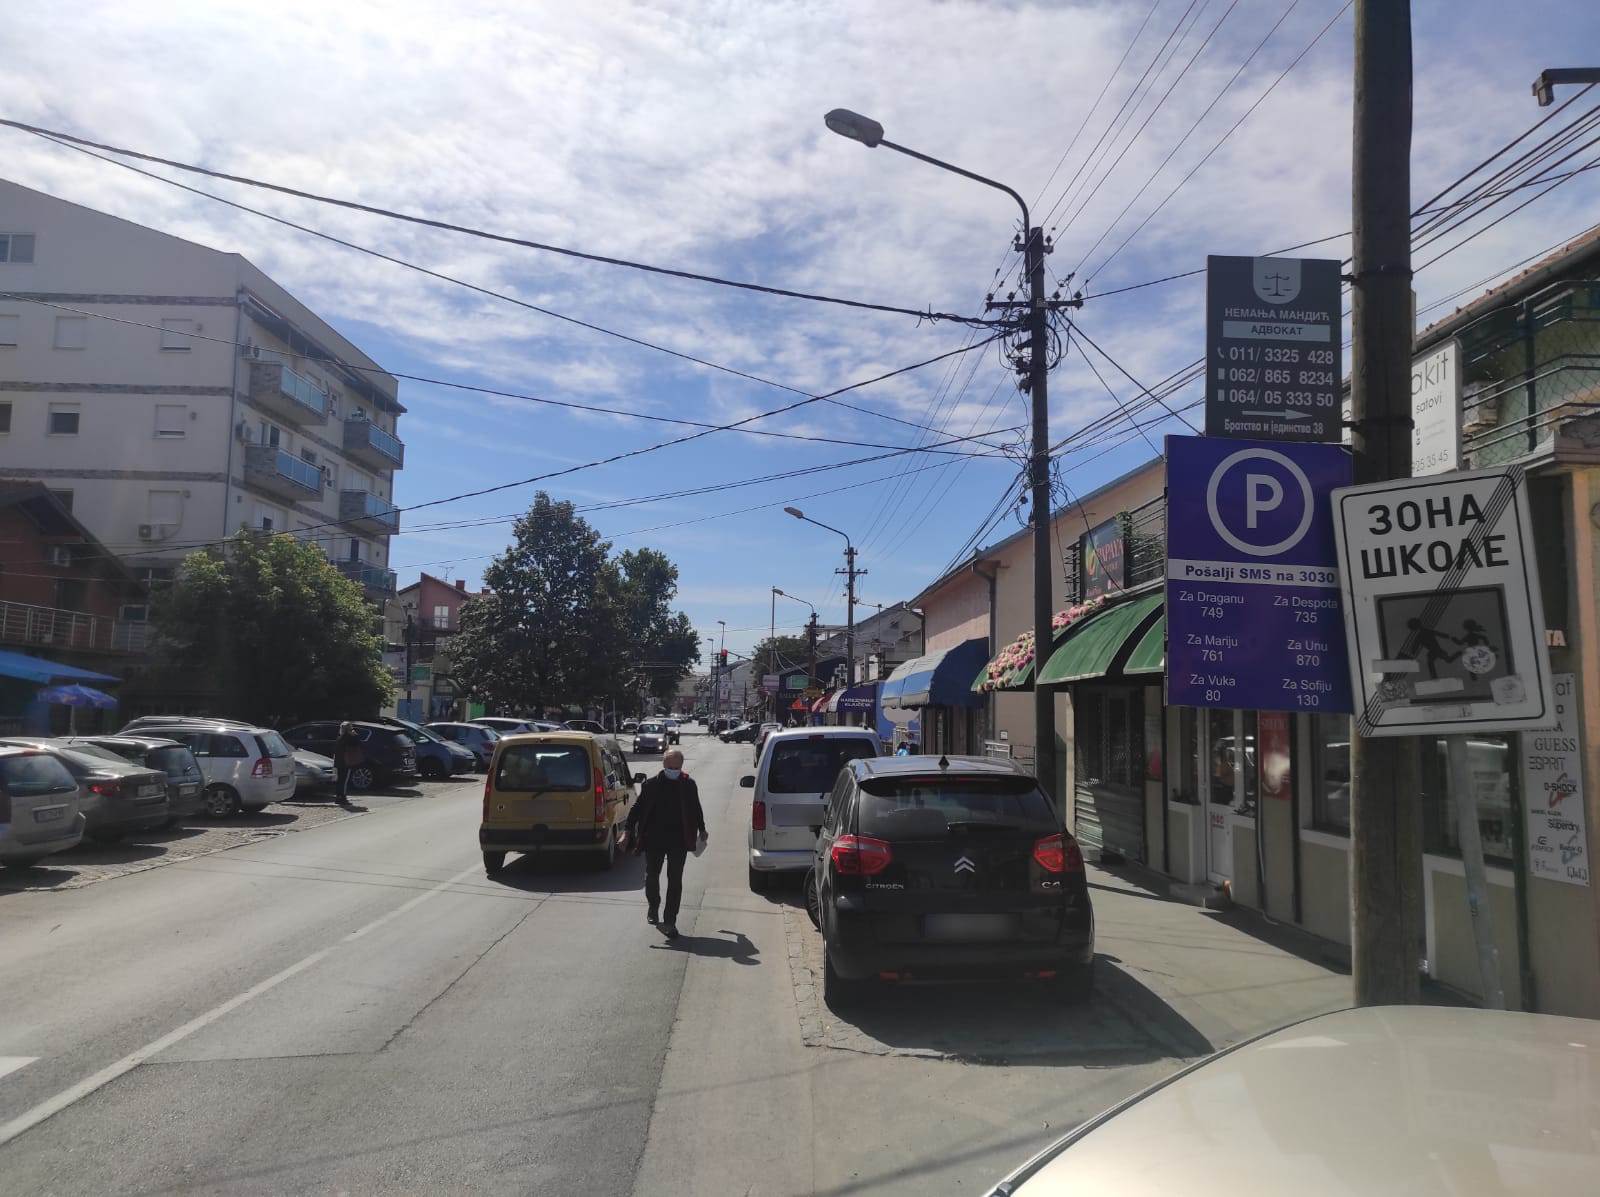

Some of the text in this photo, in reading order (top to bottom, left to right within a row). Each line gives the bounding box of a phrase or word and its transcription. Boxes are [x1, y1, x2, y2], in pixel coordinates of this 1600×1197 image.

[1225, 308, 1330, 322] НЕМАЊА МАНДИЋ
[1251, 325, 1304, 336] АДВОКАТ
[1229, 347, 1334, 365] 011/ 3325 428
[1229, 368, 1334, 386] 062/ 865 8234
[1229, 389, 1334, 407] 064/ 05 333 50
[1224, 418, 1262, 433] Братство
[1263, 423, 1269, 431] и
[1312, 422, 1324, 434] 38
[1246, 473, 1284, 529] P
[1367, 493, 1485, 536] ЗОНА
[1360, 534, 1509, 580] ШКОЛЕ
[1185, 564, 1335, 583] Pošalji SMS na 3030
[1179, 590, 1244, 606] Za Draganu
[1273, 596, 1338, 611] Za Despota
[1201, 606, 1224, 619] 749
[1295, 612, 1318, 623] 735
[1187, 634, 1238, 649] Za Mariju
[1287, 640, 1303, 651] Za
[1201, 649, 1224, 662] 761
[1296, 655, 1320, 667] 870
[1190, 674, 1236, 688] Za Vuka
[1282, 679, 1333, 693] Za Sofiju
[1205, 690, 1221, 702] 80
[1296, 695, 1319, 707] 130
[1534, 737, 1577, 752] GUESS
[1528, 756, 1565, 771] ESPRIT
[1041, 880, 1061, 889] C4
